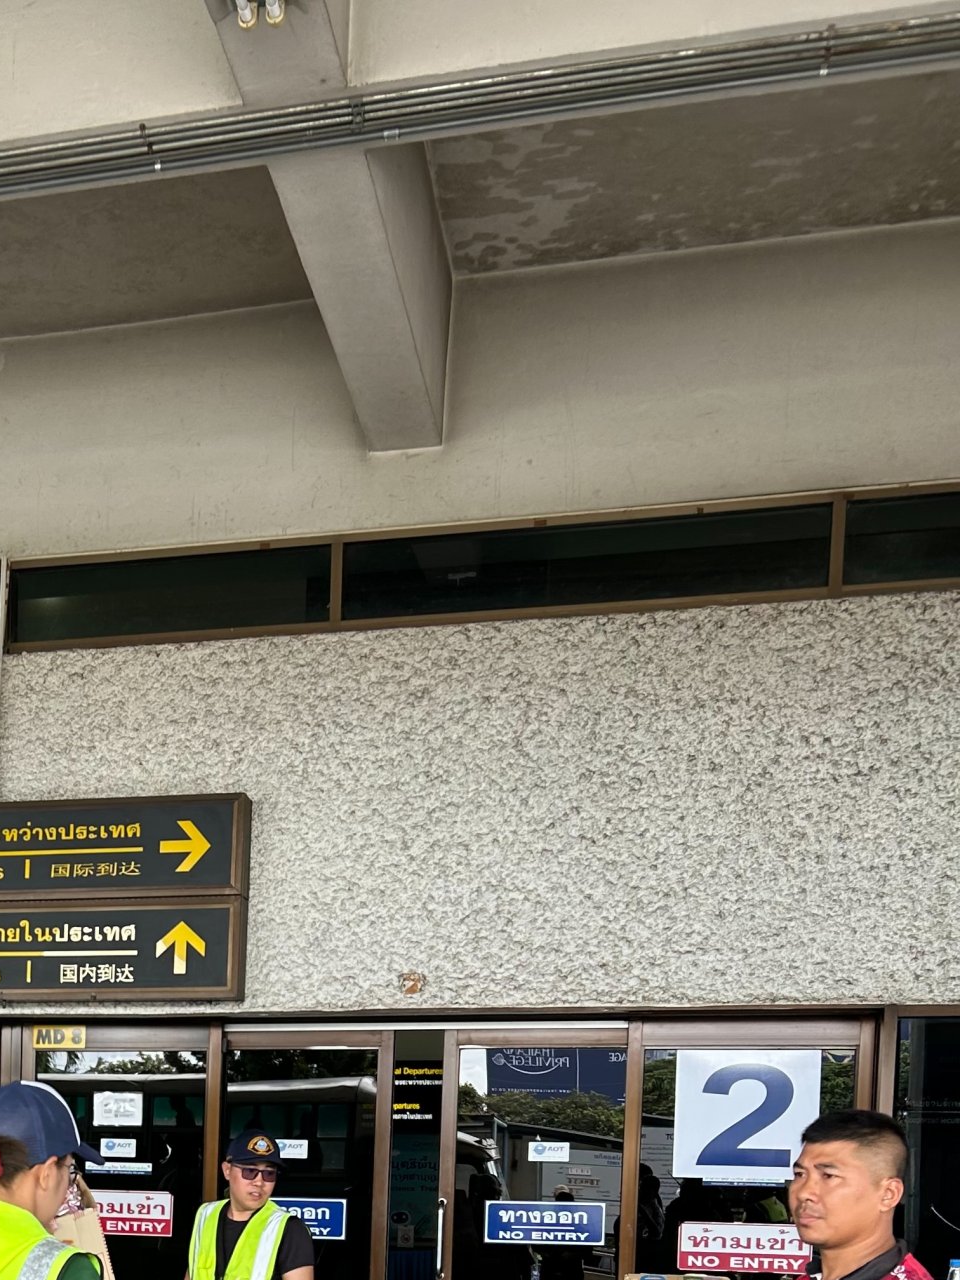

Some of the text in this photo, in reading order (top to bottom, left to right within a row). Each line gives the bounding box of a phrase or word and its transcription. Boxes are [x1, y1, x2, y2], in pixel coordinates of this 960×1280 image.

[50, 861, 141, 878] 国际到达
[59, 963, 135, 984] 国内到达
[36, 1028, 83, 1045] MD 8
[696, 1063, 794, 1167] 2
[498, 1210, 588, 1224] ทางออก
[106, 1221, 166, 1232] ENTRY
[498, 1231, 590, 1241] NO ENTRY
[687, 1227, 804, 1251] ห้ามเข้า
[688, 1255, 805, 1270] NO ENTRY
